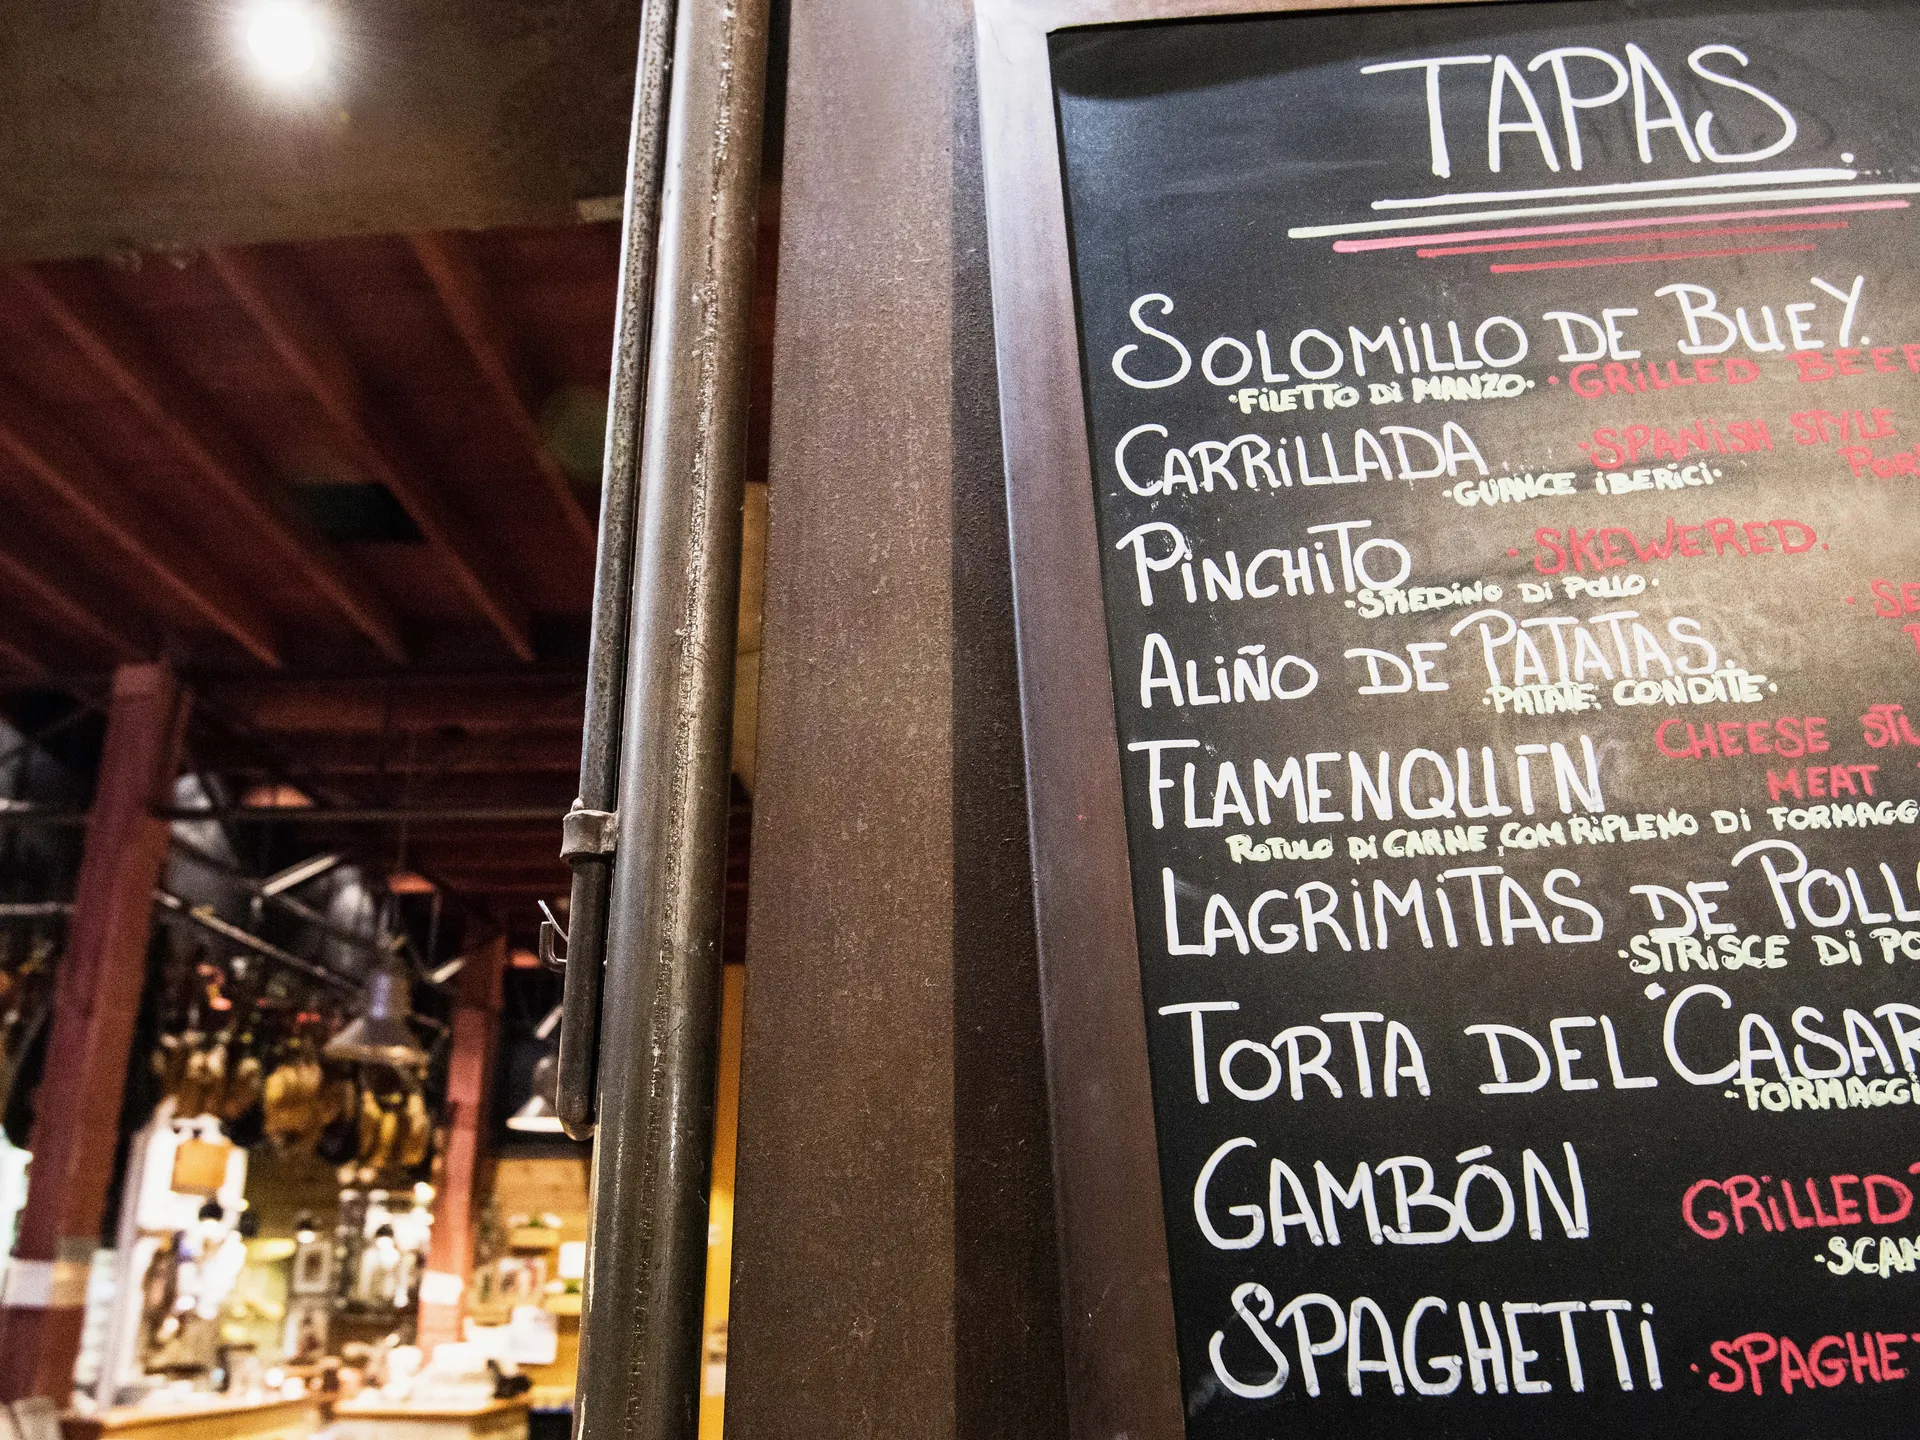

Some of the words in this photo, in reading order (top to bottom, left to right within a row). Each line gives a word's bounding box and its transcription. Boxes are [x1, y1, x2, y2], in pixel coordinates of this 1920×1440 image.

[1543, 308, 1641, 361] DE
[1412, 373, 1526, 403] MANZO
[1790, 408, 1896, 445] STYLE
[1837, 443, 1920, 479] POR
[1344, 642, 1449, 694] DE
[1655, 717, 1830, 759] CHEESE
[1766, 764, 1879, 801] MEAT
[1767, 800, 1920, 831] FORMAGG
[1629, 881, 1737, 938] DE
[1731, 839, 1920, 930] POLL
[1158, 1000, 1431, 1104] TORTA
[1463, 1014, 1658, 1096] DEL
[1663, 984, 1920, 1086] CASAR
[1708, 1331, 1920, 1397] SPAGHE
